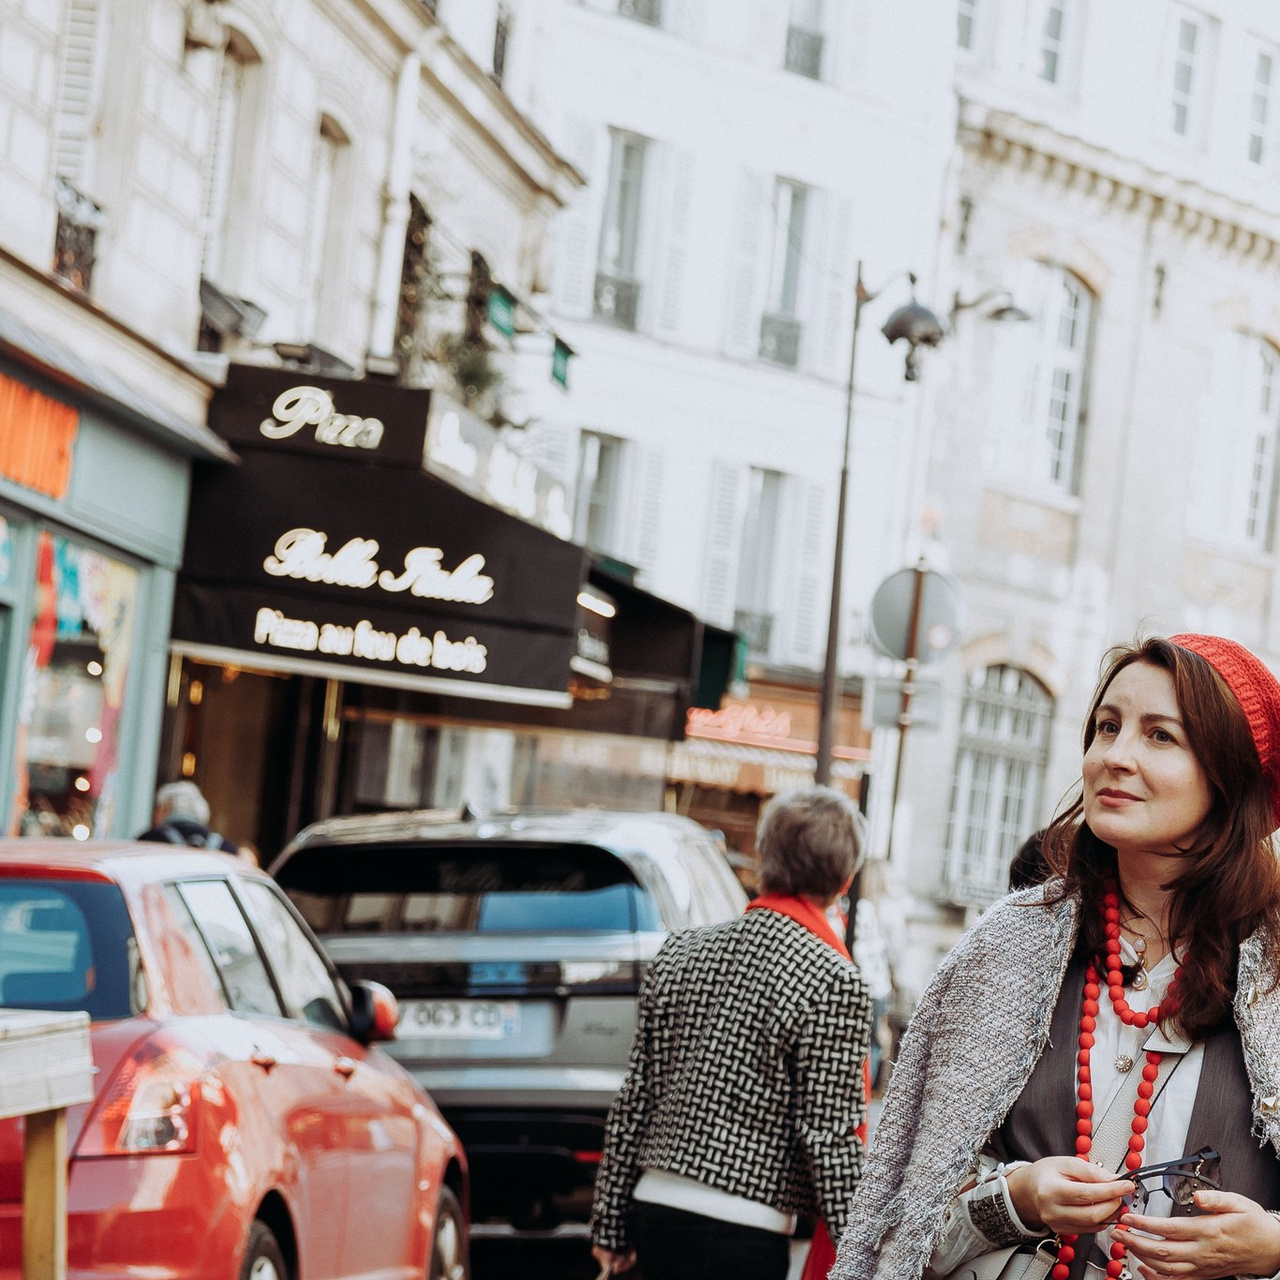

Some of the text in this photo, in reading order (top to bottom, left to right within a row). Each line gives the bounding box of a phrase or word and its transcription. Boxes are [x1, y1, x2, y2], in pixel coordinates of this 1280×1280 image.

[260, 386, 384, 449] Pizza
[254, 607, 488, 674] Pizza au feu de bois
